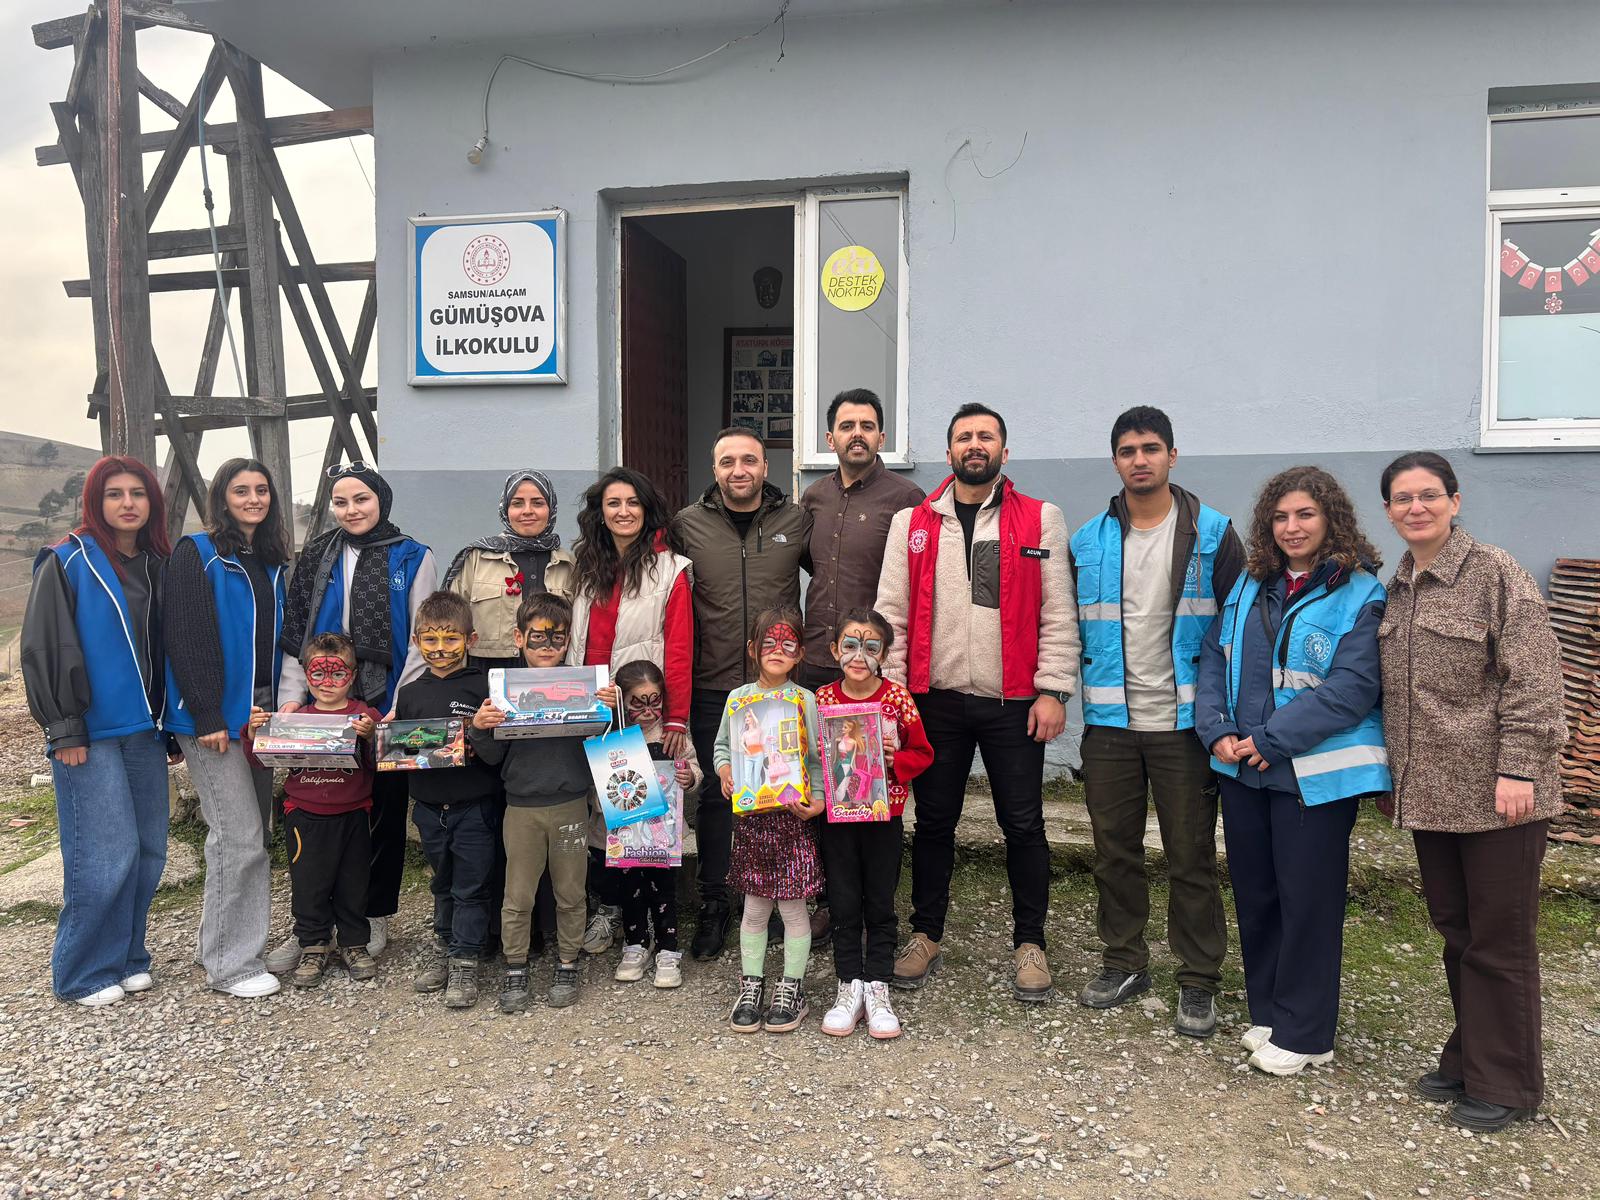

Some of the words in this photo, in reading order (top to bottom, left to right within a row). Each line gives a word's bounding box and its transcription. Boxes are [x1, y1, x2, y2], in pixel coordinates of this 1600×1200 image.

[829, 274, 879, 288] DESTEK
[448, 288, 527, 299] SAMSUN/ALAÇAM
[827, 286, 877, 298] NOKTASI
[430, 304, 545, 328] GÜMÜŞOVA
[436, 335, 540, 356] İLKOKULU
[300, 775, 345, 785] California
[834, 805, 871, 817] Bamby
[624, 846, 667, 858] Fashion
